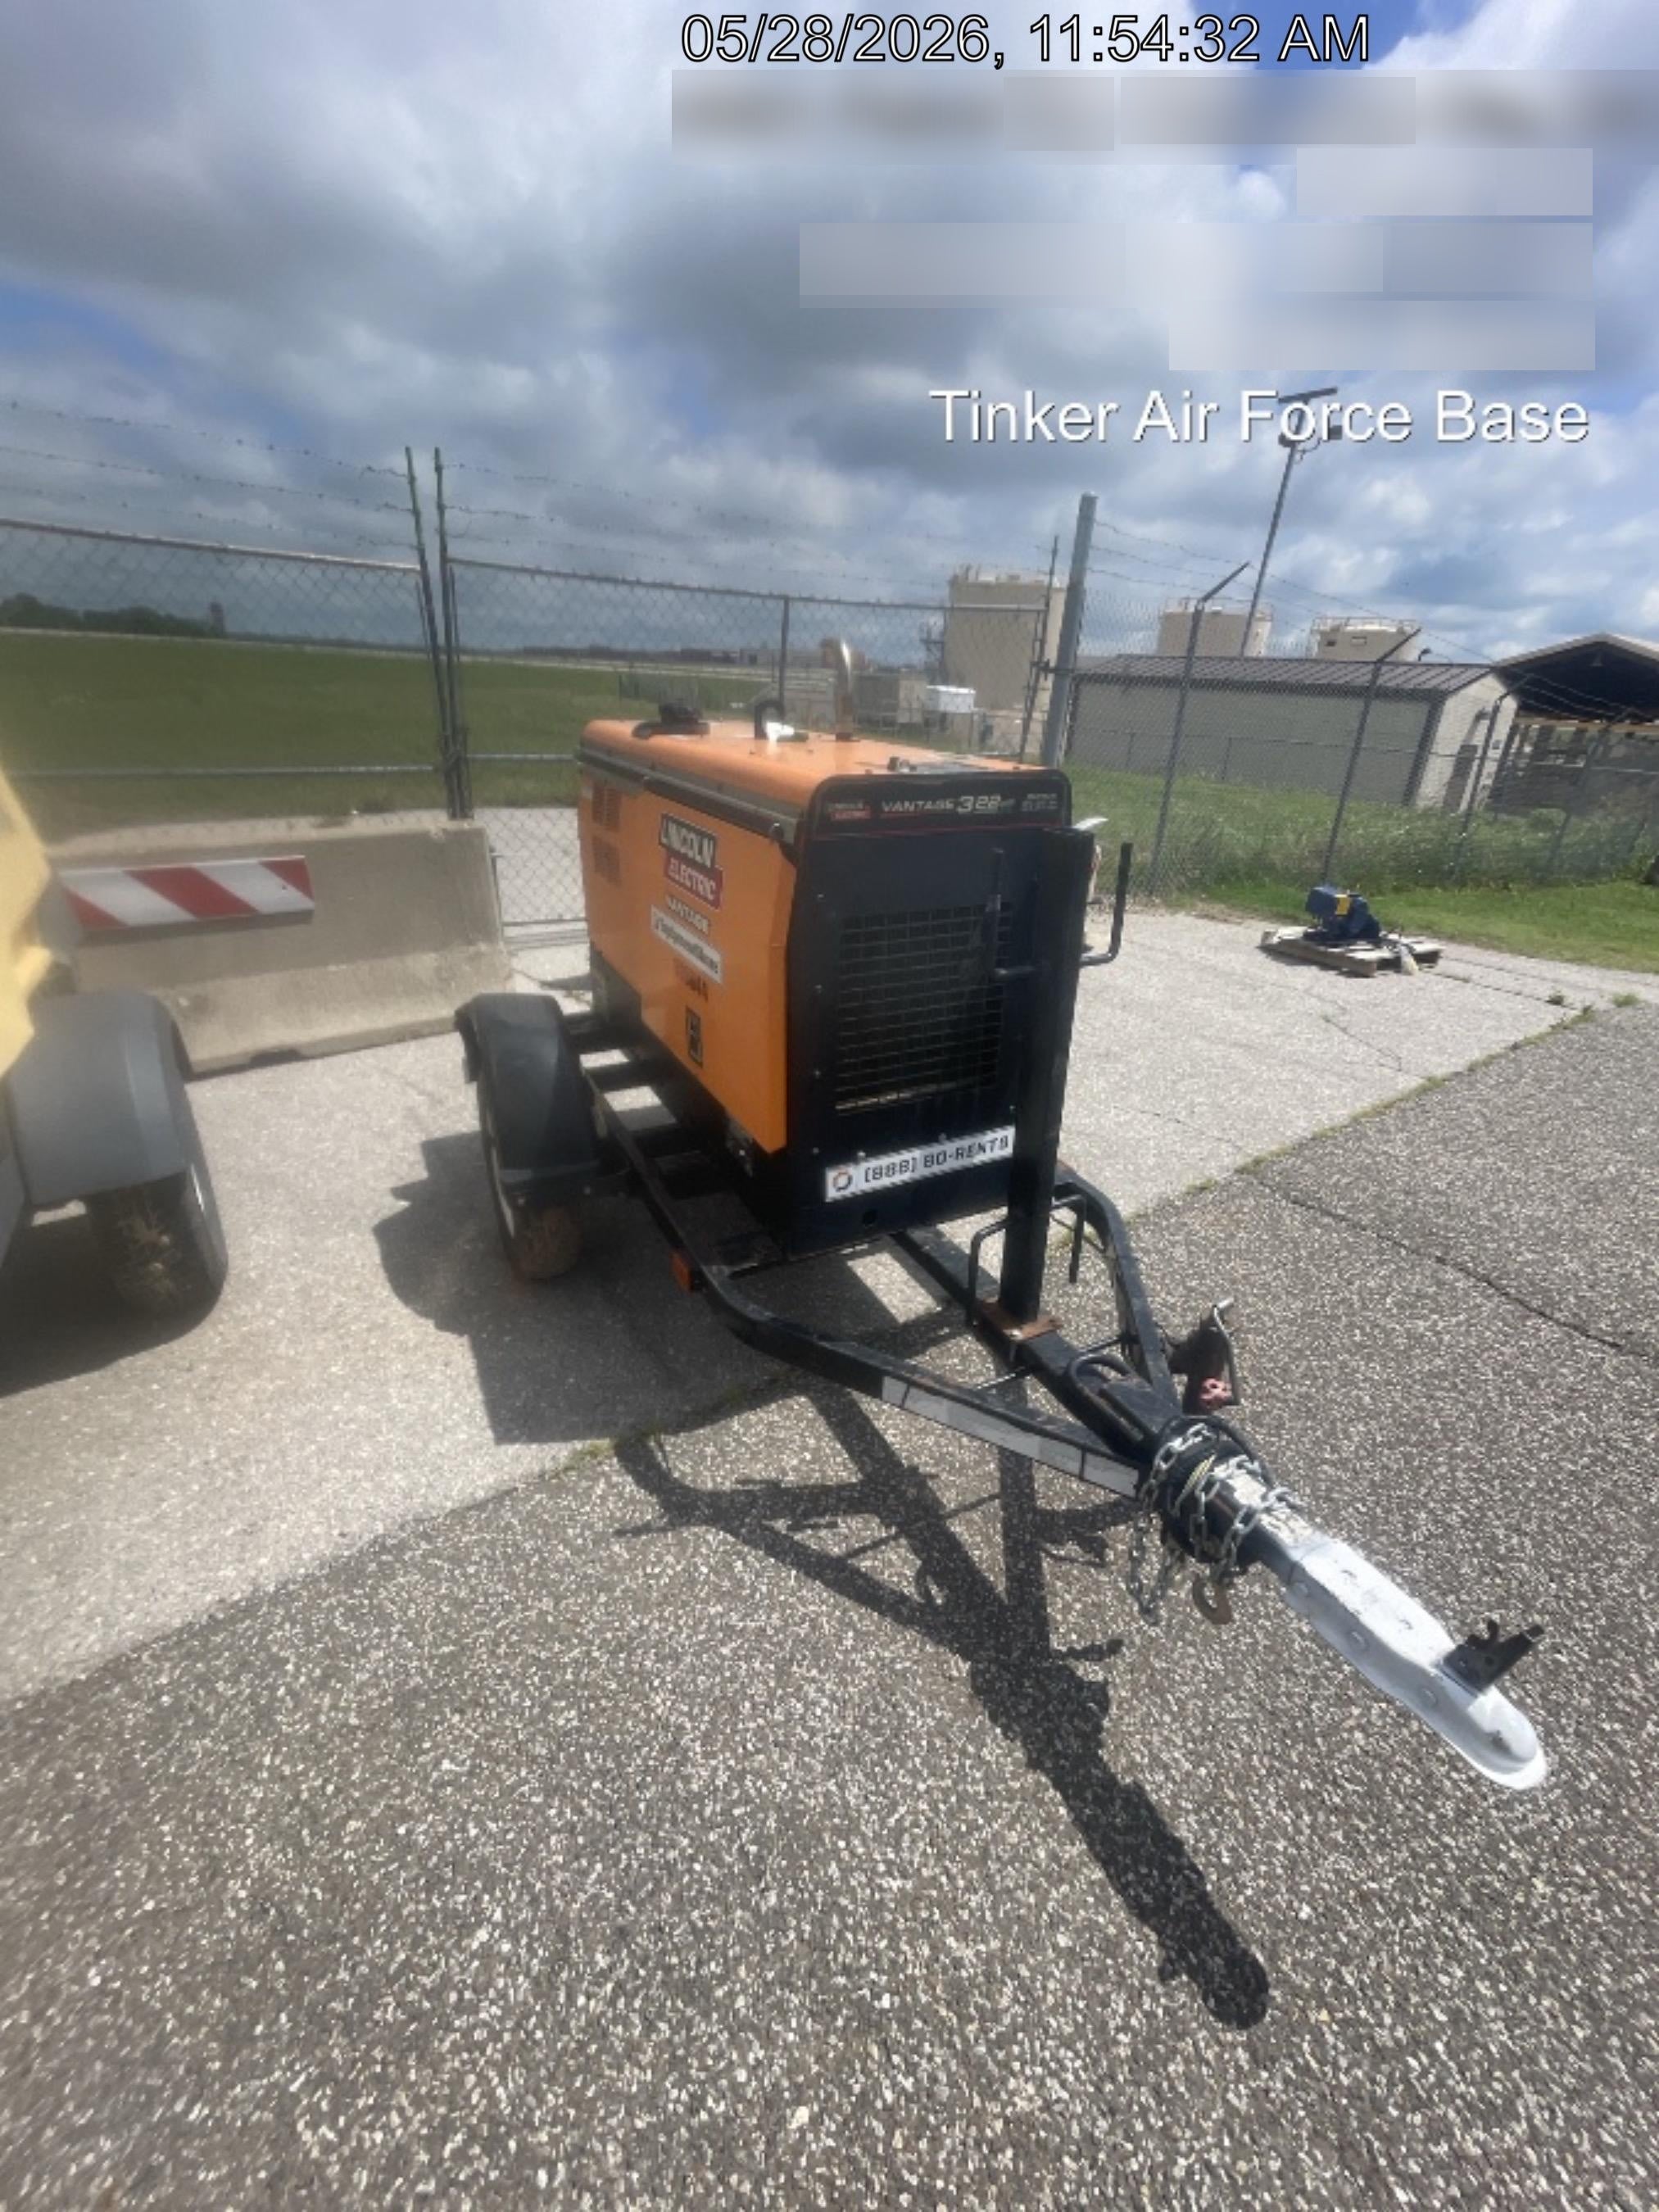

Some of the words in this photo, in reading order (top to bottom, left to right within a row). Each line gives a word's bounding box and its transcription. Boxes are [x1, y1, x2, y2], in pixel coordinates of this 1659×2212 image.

[882, 799, 956, 813] VANTAGE
[660, 818, 714, 868] LINCOLN
[668, 856, 717, 901] ELECTRIC
